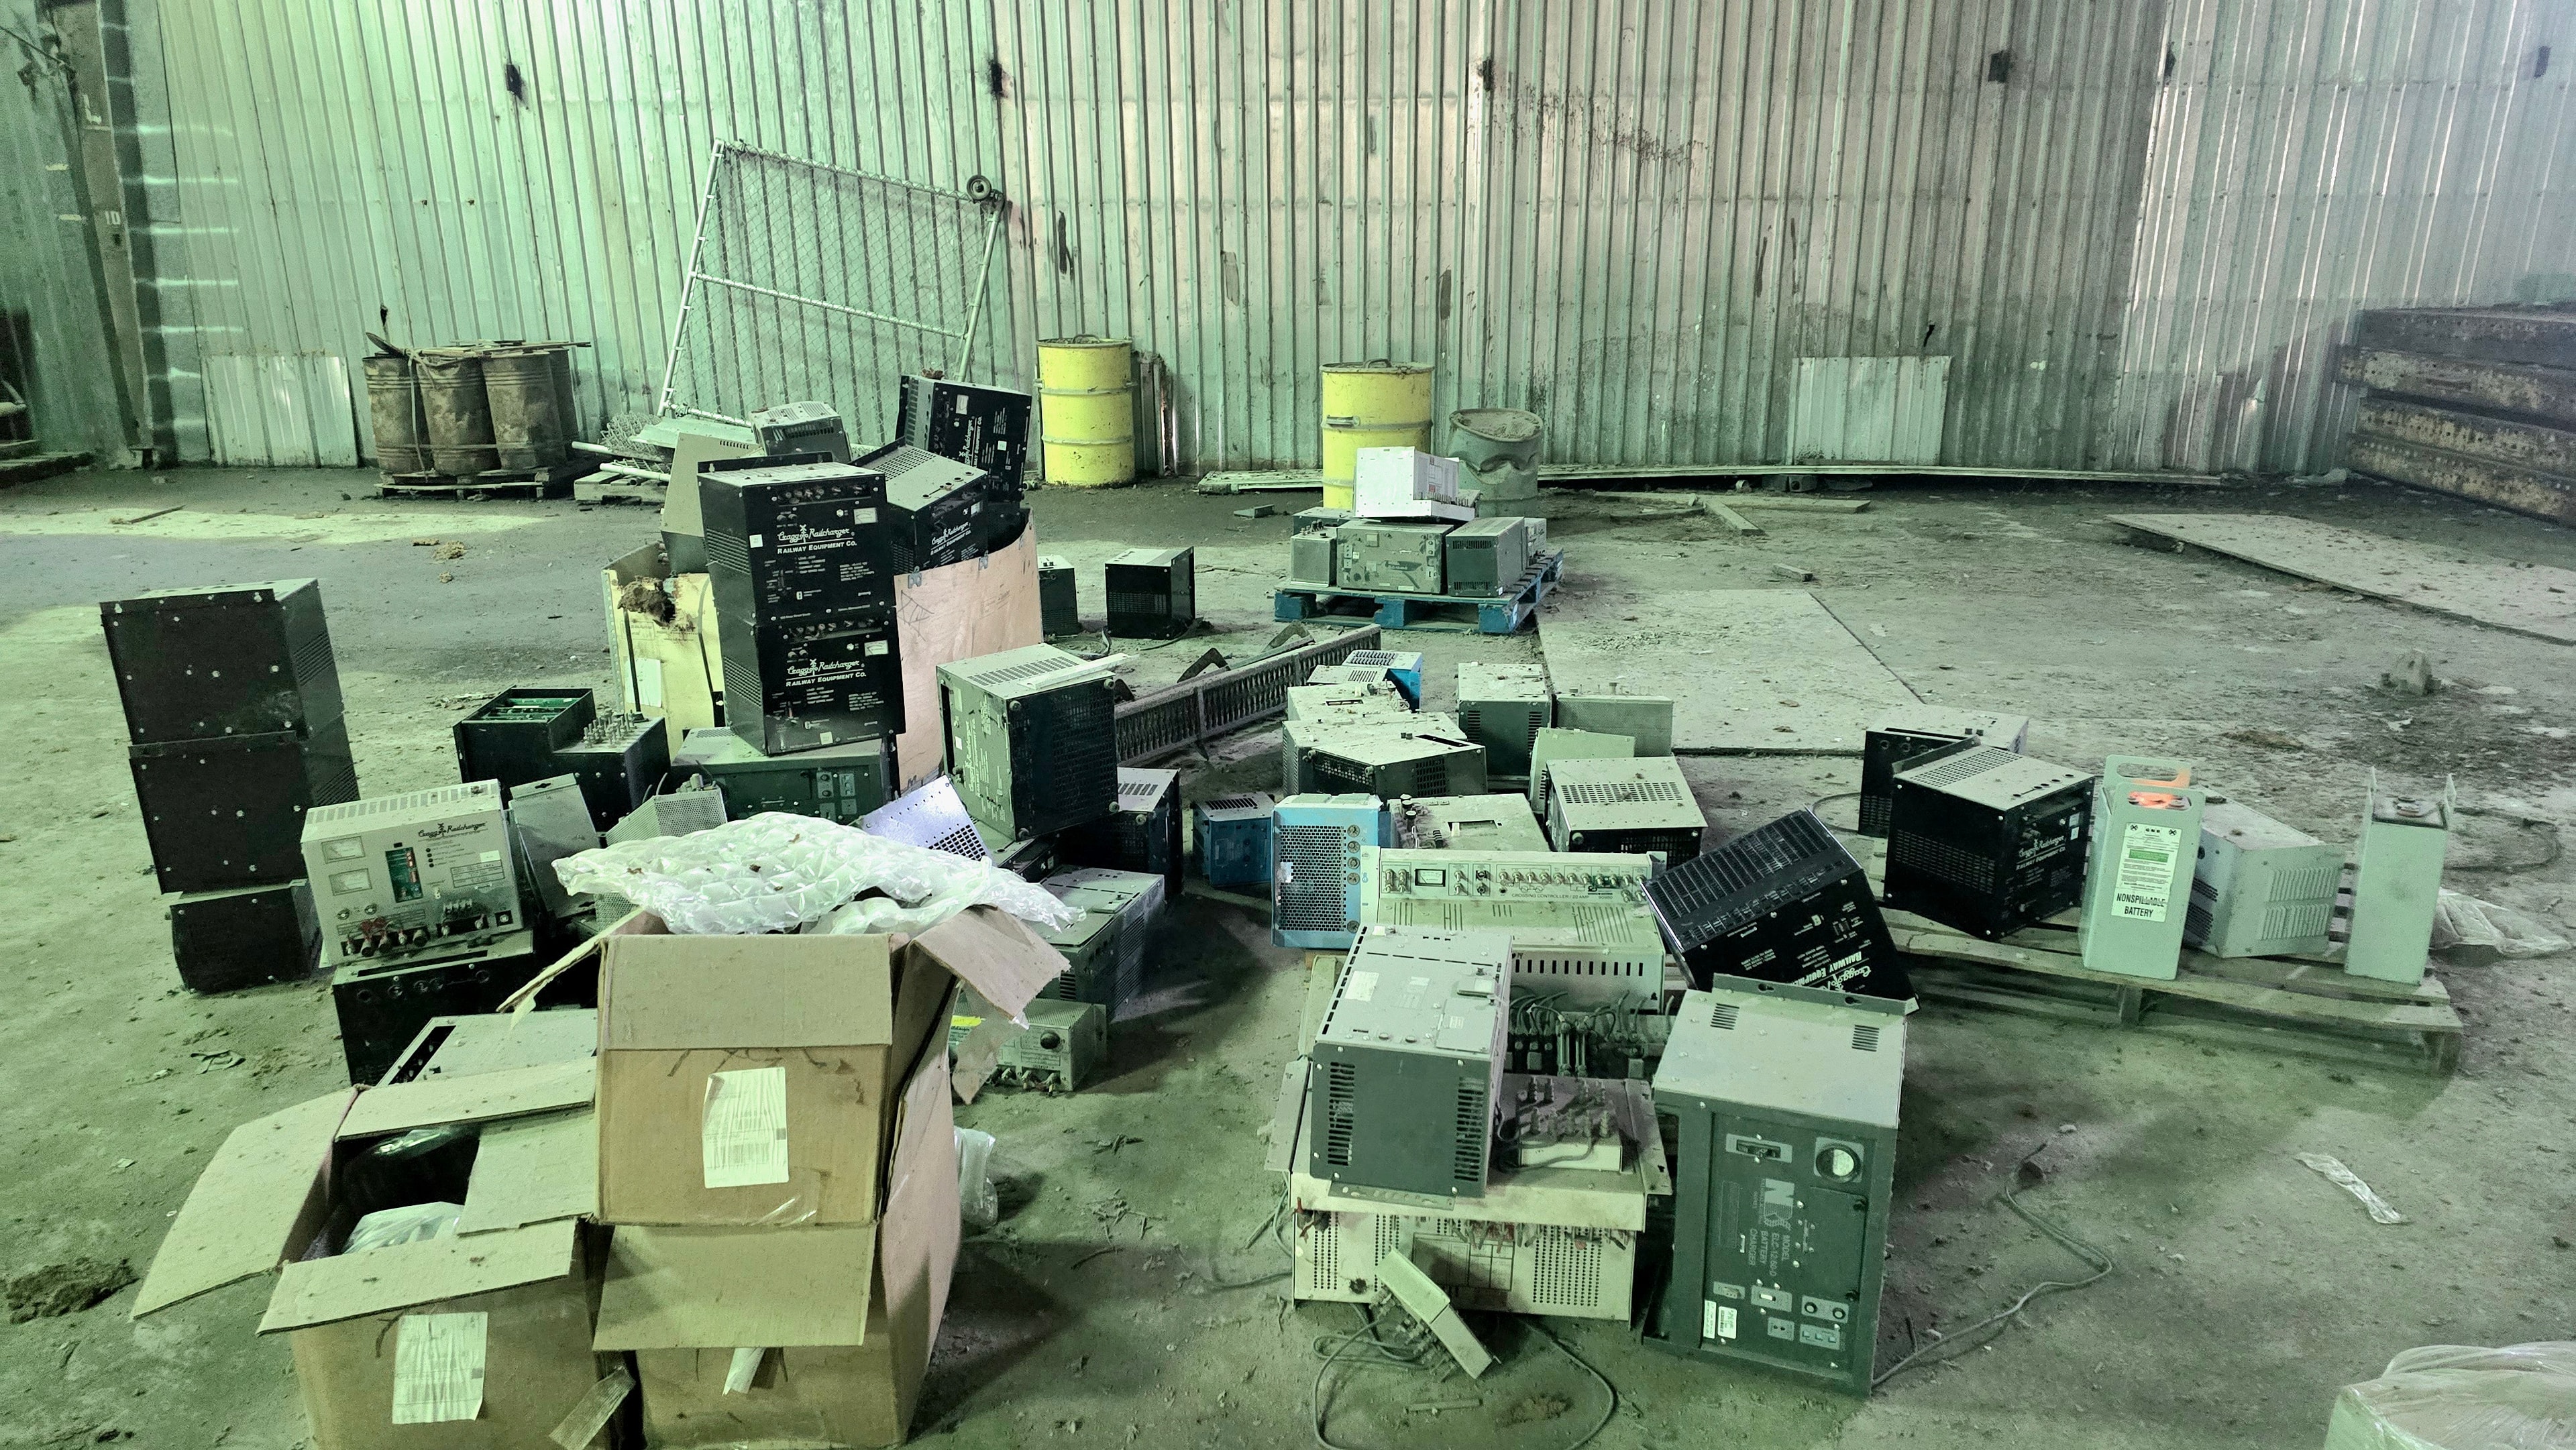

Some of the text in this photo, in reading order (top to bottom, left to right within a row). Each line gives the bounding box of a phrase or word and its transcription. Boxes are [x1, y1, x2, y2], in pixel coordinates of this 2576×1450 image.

[808, 528, 850, 539] Railcharger
[777, 546, 806, 554] RAILWAY
[808, 541, 845, 551] EQUIPMENT
[818, 661, 859, 671] Railcharger
[786, 678, 815, 687] RAILWAY
[817, 673, 853, 683] EQUIPMENT
[447, 822, 486, 833] Railcharger
[2125, 906, 2153, 917] BATTERY
[1829, 951, 1862, 972] RAILWAY
[1748, 1228, 1758, 1266] CHARGER
[1760, 1230, 1769, 1265] BATTERY
[1781, 1235, 1790, 1262] MODEL
